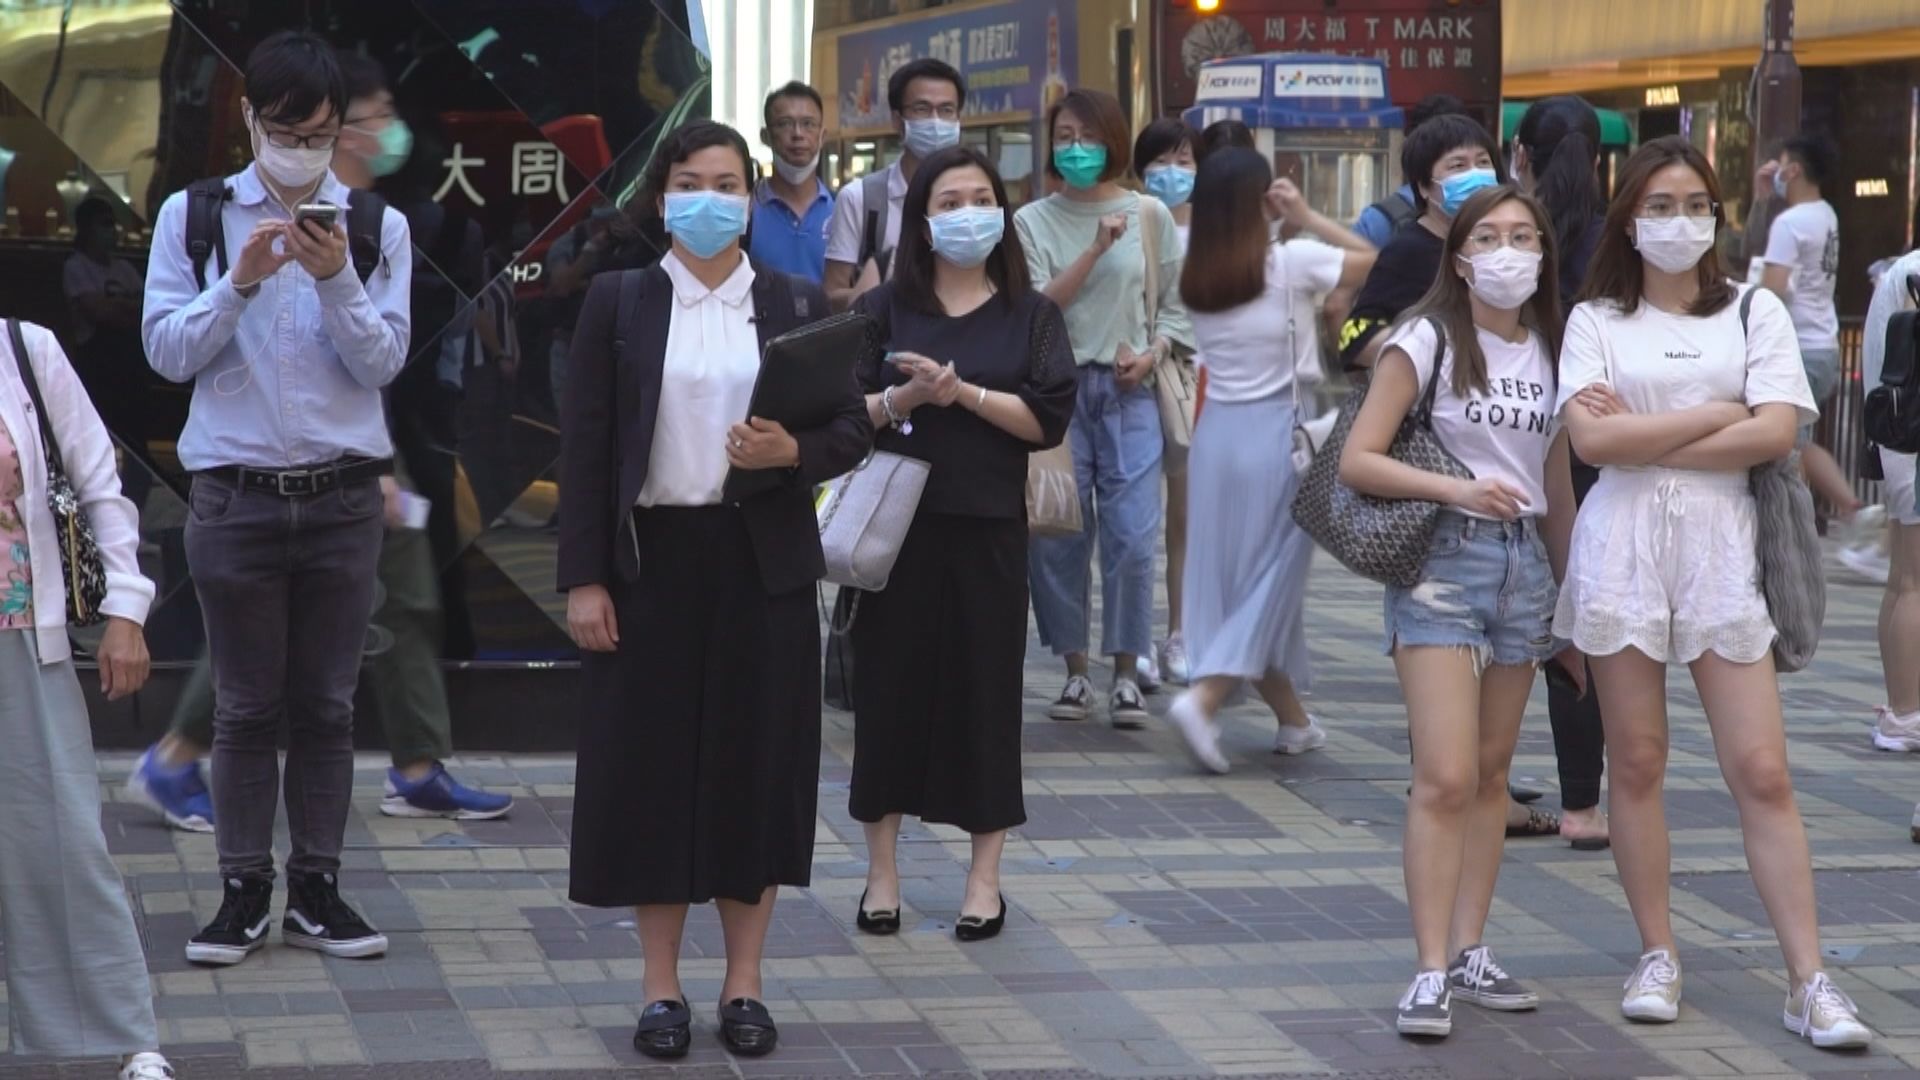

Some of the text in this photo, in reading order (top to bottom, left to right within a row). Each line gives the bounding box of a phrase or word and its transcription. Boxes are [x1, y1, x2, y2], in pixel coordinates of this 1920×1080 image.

[1264, 17, 1474, 41] 周大福 T MARK
[1306, 75, 1344, 87] PCCW
